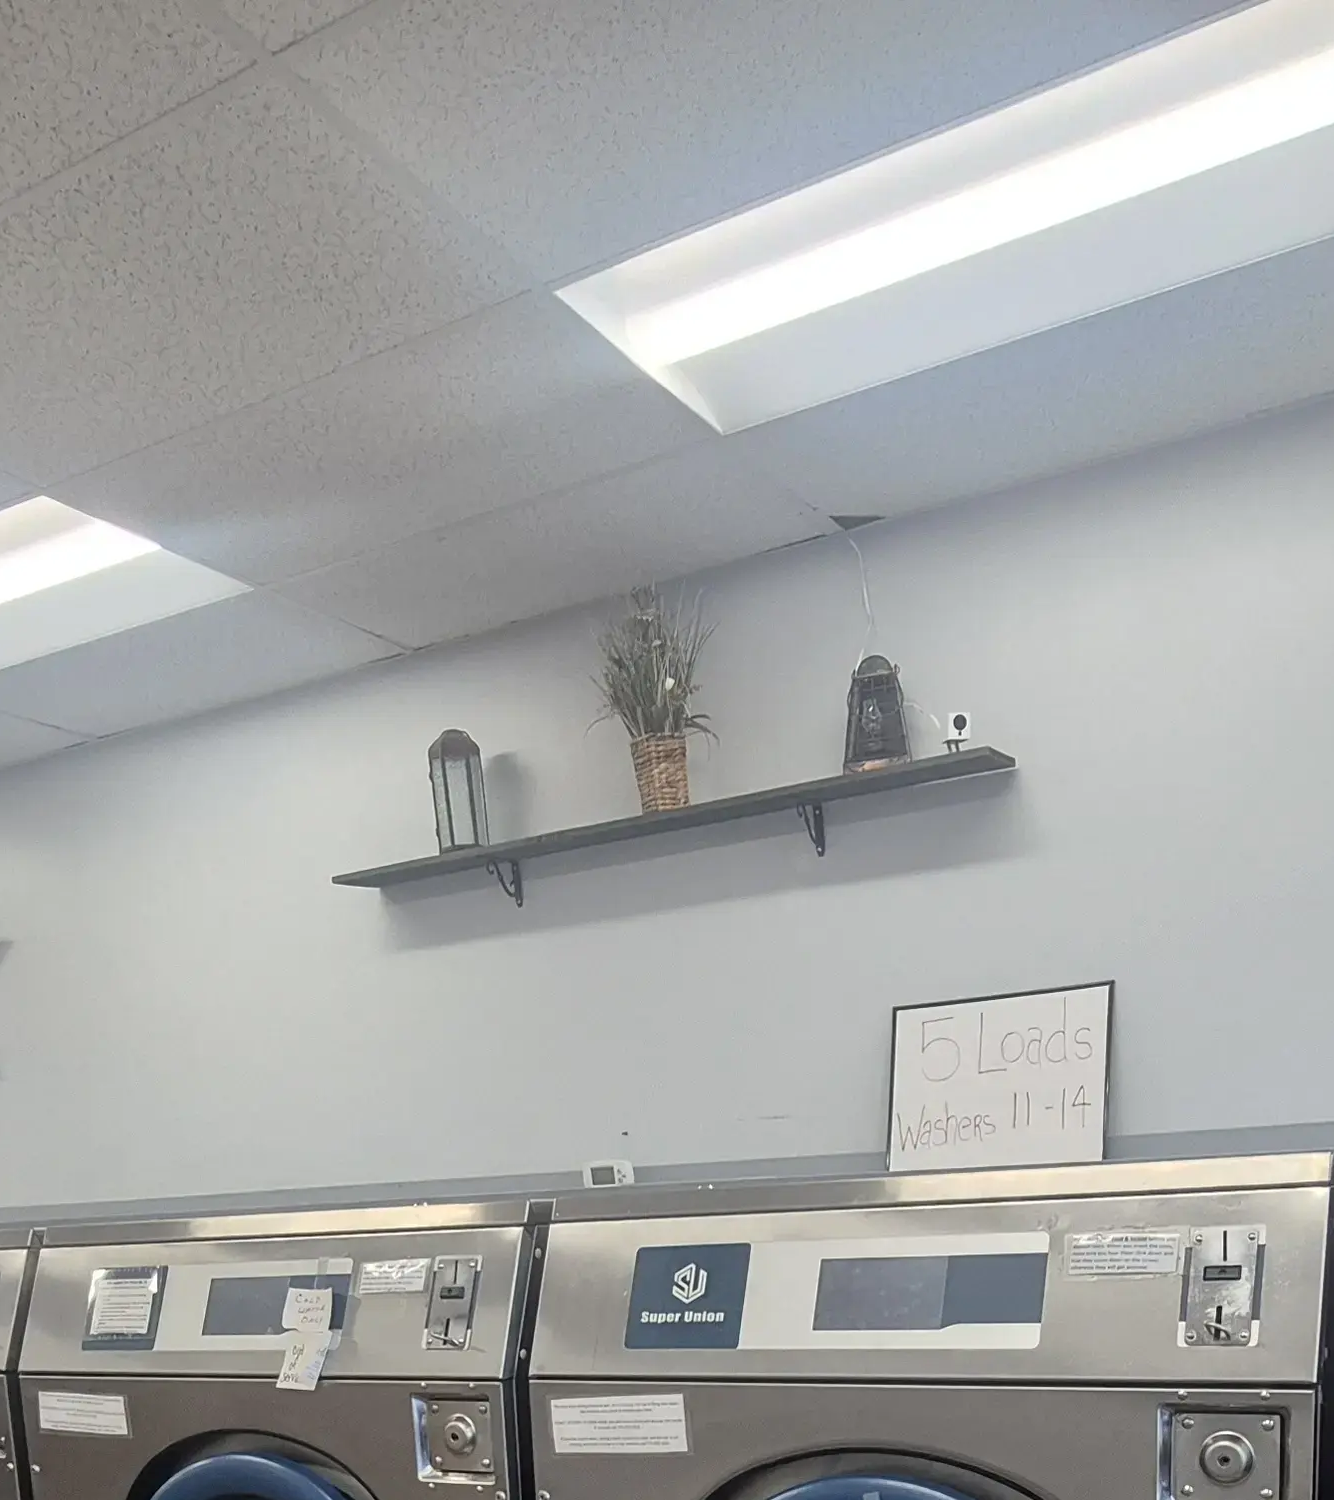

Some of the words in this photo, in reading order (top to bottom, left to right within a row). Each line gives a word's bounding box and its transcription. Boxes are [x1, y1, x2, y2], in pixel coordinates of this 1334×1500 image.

[921, 1016, 961, 1082] 5
[977, 996, 1094, 1075] Loads
[895, 1100, 997, 1152] Washers
[640, 1310, 682, 1324] Super
[683, 1310, 725, 1323] Union
